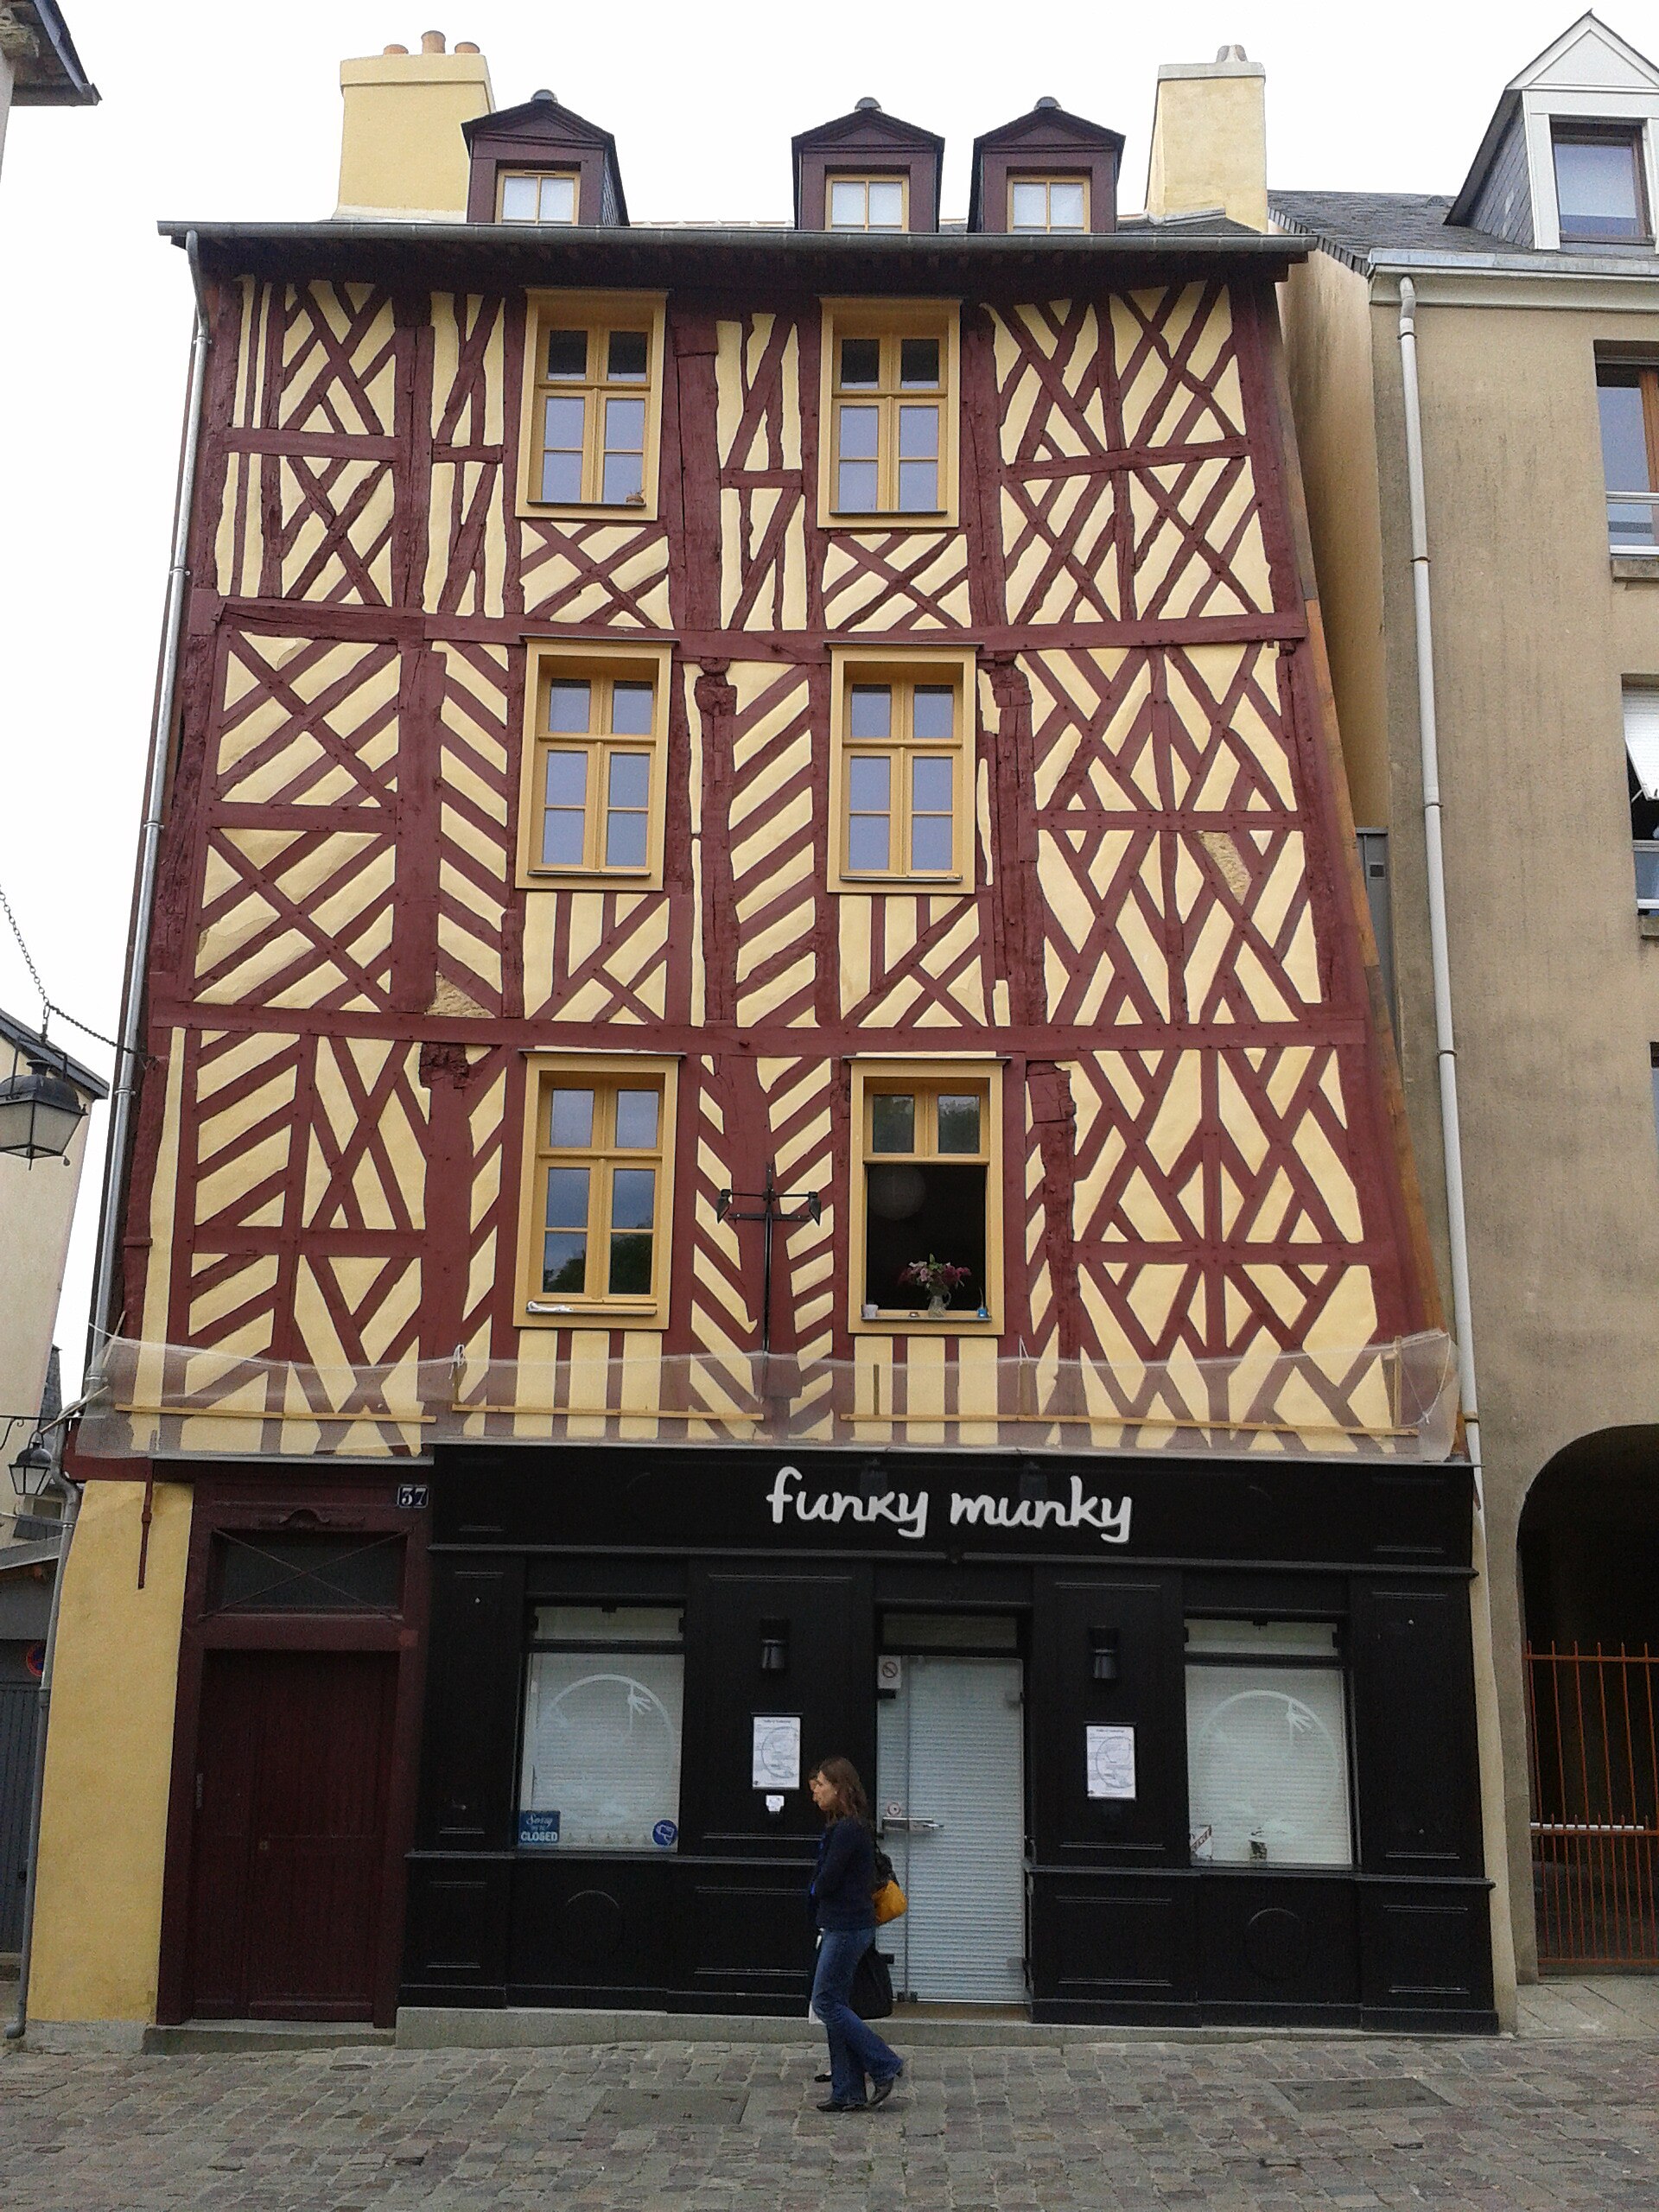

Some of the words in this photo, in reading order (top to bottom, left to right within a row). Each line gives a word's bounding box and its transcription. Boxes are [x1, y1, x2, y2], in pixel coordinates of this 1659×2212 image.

[402, 1487, 427, 1505] 37
[766, 1466, 929, 1538] funky
[950, 1475, 1132, 1543] munky
[520, 1831, 558, 1841] CLOSED
